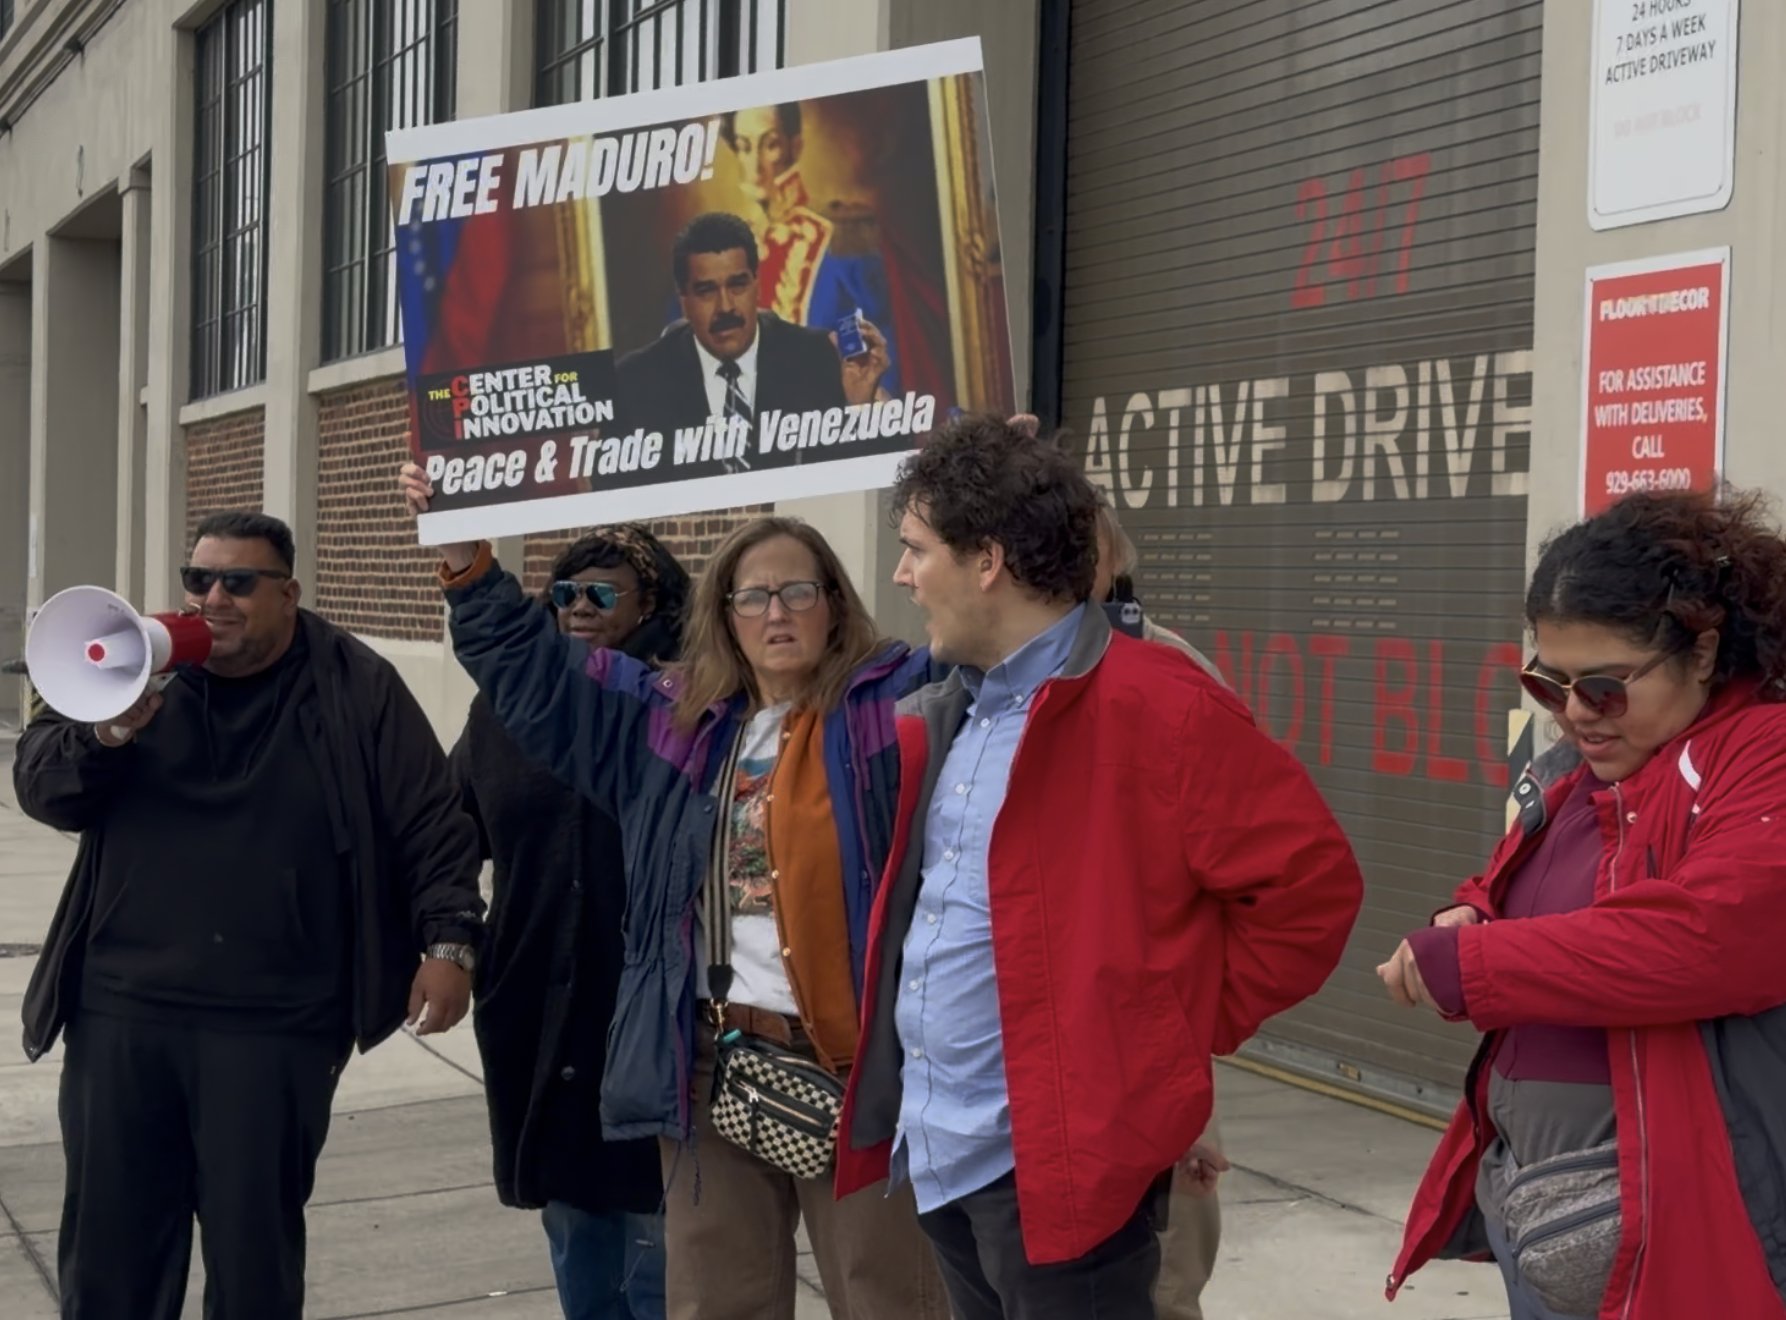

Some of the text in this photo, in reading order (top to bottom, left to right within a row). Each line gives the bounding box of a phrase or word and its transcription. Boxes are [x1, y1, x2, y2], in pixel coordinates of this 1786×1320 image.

[1632, 3, 1646, 22] 24
[1616, 13, 1706, 55] 7 DAYS A WEEK
[1605, 39, 1717, 85] ACTIVE DRIVEWAY
[398, 117, 722, 226] FREE MADURO!
[1289, 152, 1432, 309] 24/7
[428, 364, 578, 401] THE CENTER FOR
[1598, 360, 1706, 394] FOR ASSISTANCE
[453, 382, 587, 418] POLITICAL
[454, 399, 614, 440] INNOVATION
[1594, 397, 1708, 428] WITH DELIVERIES,
[426, 390, 936, 495] Peace & Trade with Venezuela
[1084, 349, 1534, 509] ACTIVE DRIVE
[1632, 434, 1665, 459] CALL
